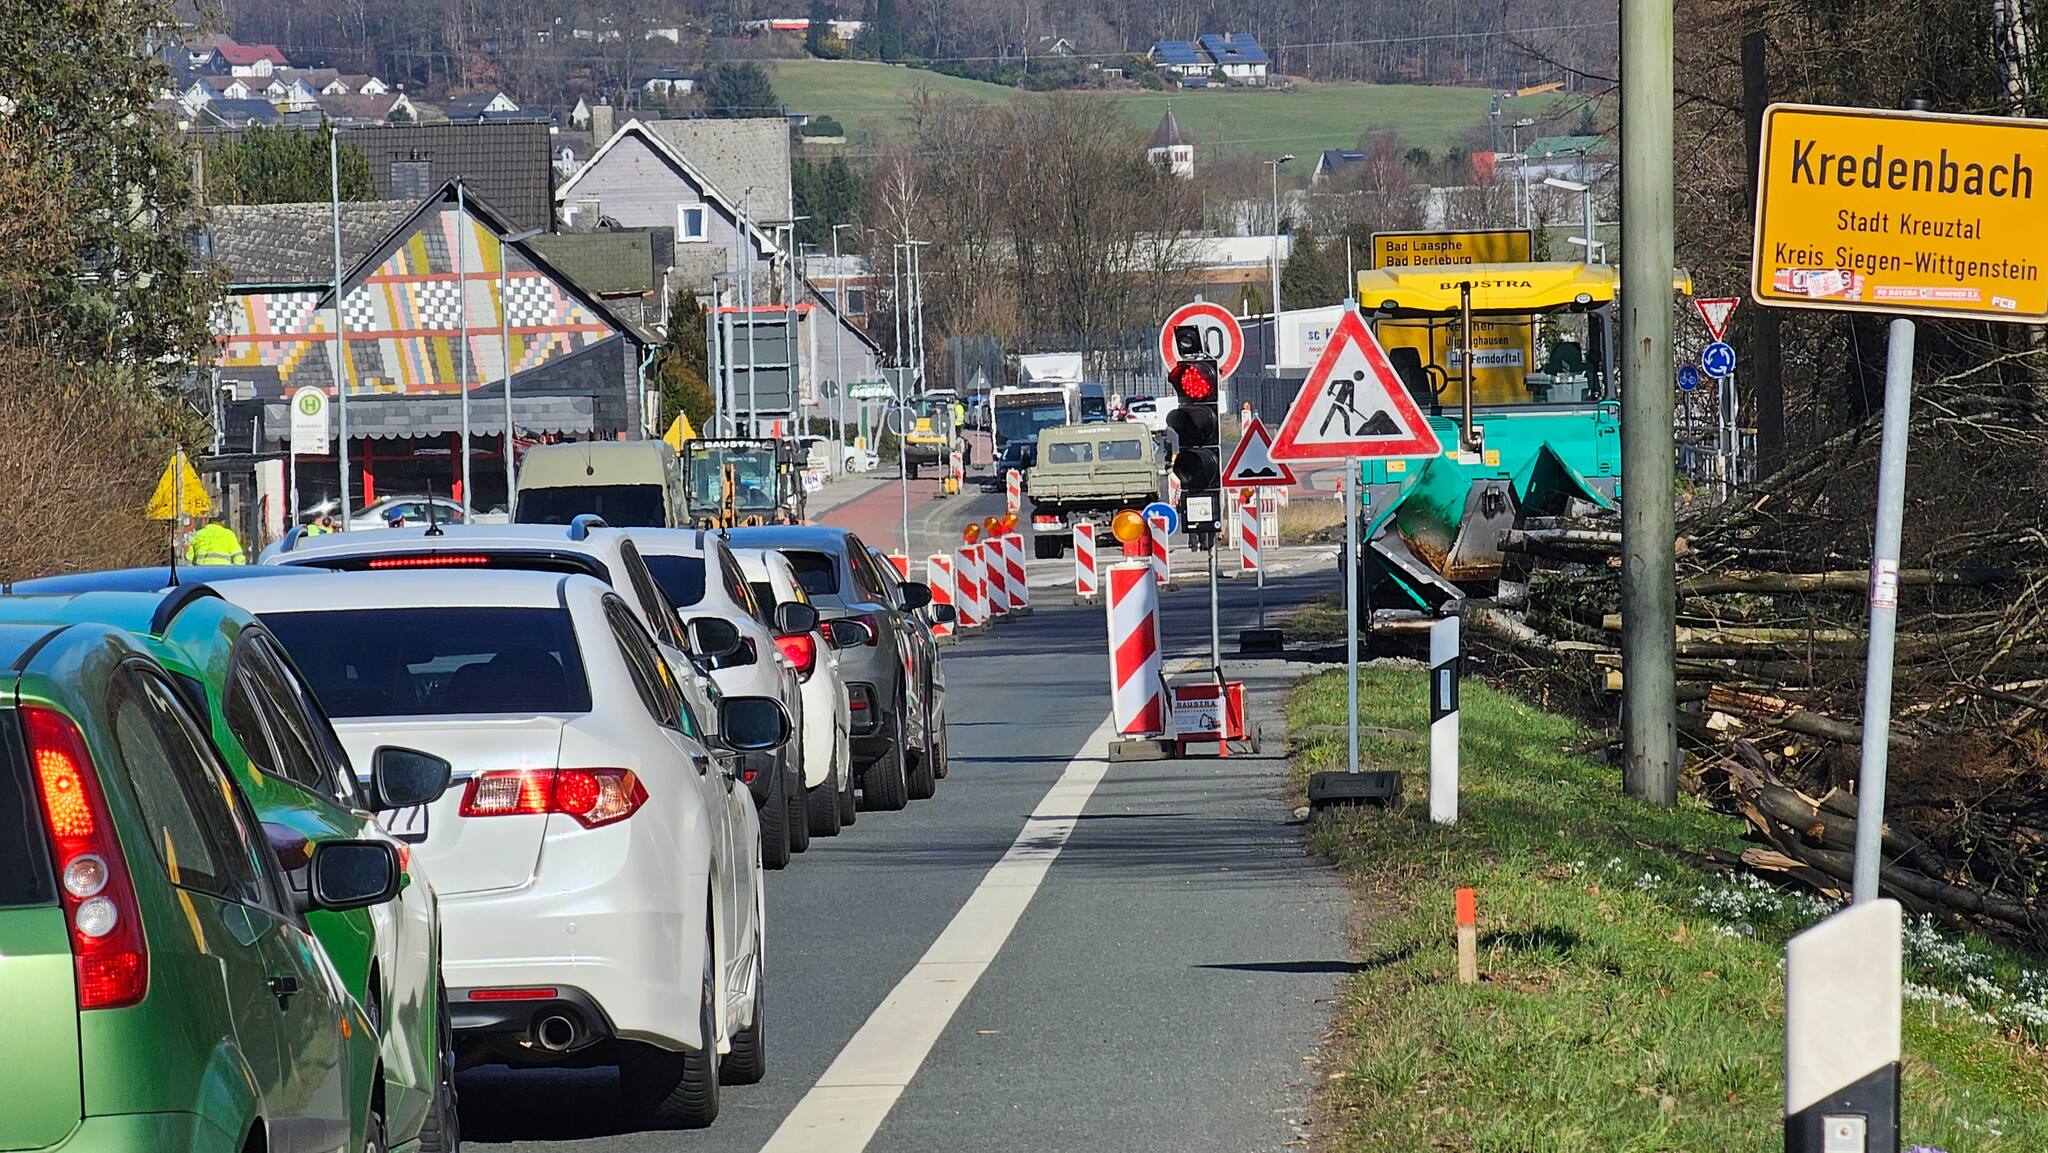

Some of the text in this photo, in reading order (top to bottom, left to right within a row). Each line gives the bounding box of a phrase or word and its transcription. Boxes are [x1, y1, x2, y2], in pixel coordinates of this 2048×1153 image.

[1791, 139, 2033, 199] Kredenbach
[1837, 209, 1981, 239] Stadt Kreuztal
[1386, 240, 1462, 253] Bad Laasphe
[1386, 255, 1472, 267] Bad Berleburg
[1775, 242, 1823, 266] Kreis
[1836, 246, 2038, 281] Siegen-Wittgenstein
[1992, 296, 2016, 309] FCB
[1445, 321, 1494, 332] Nehen
